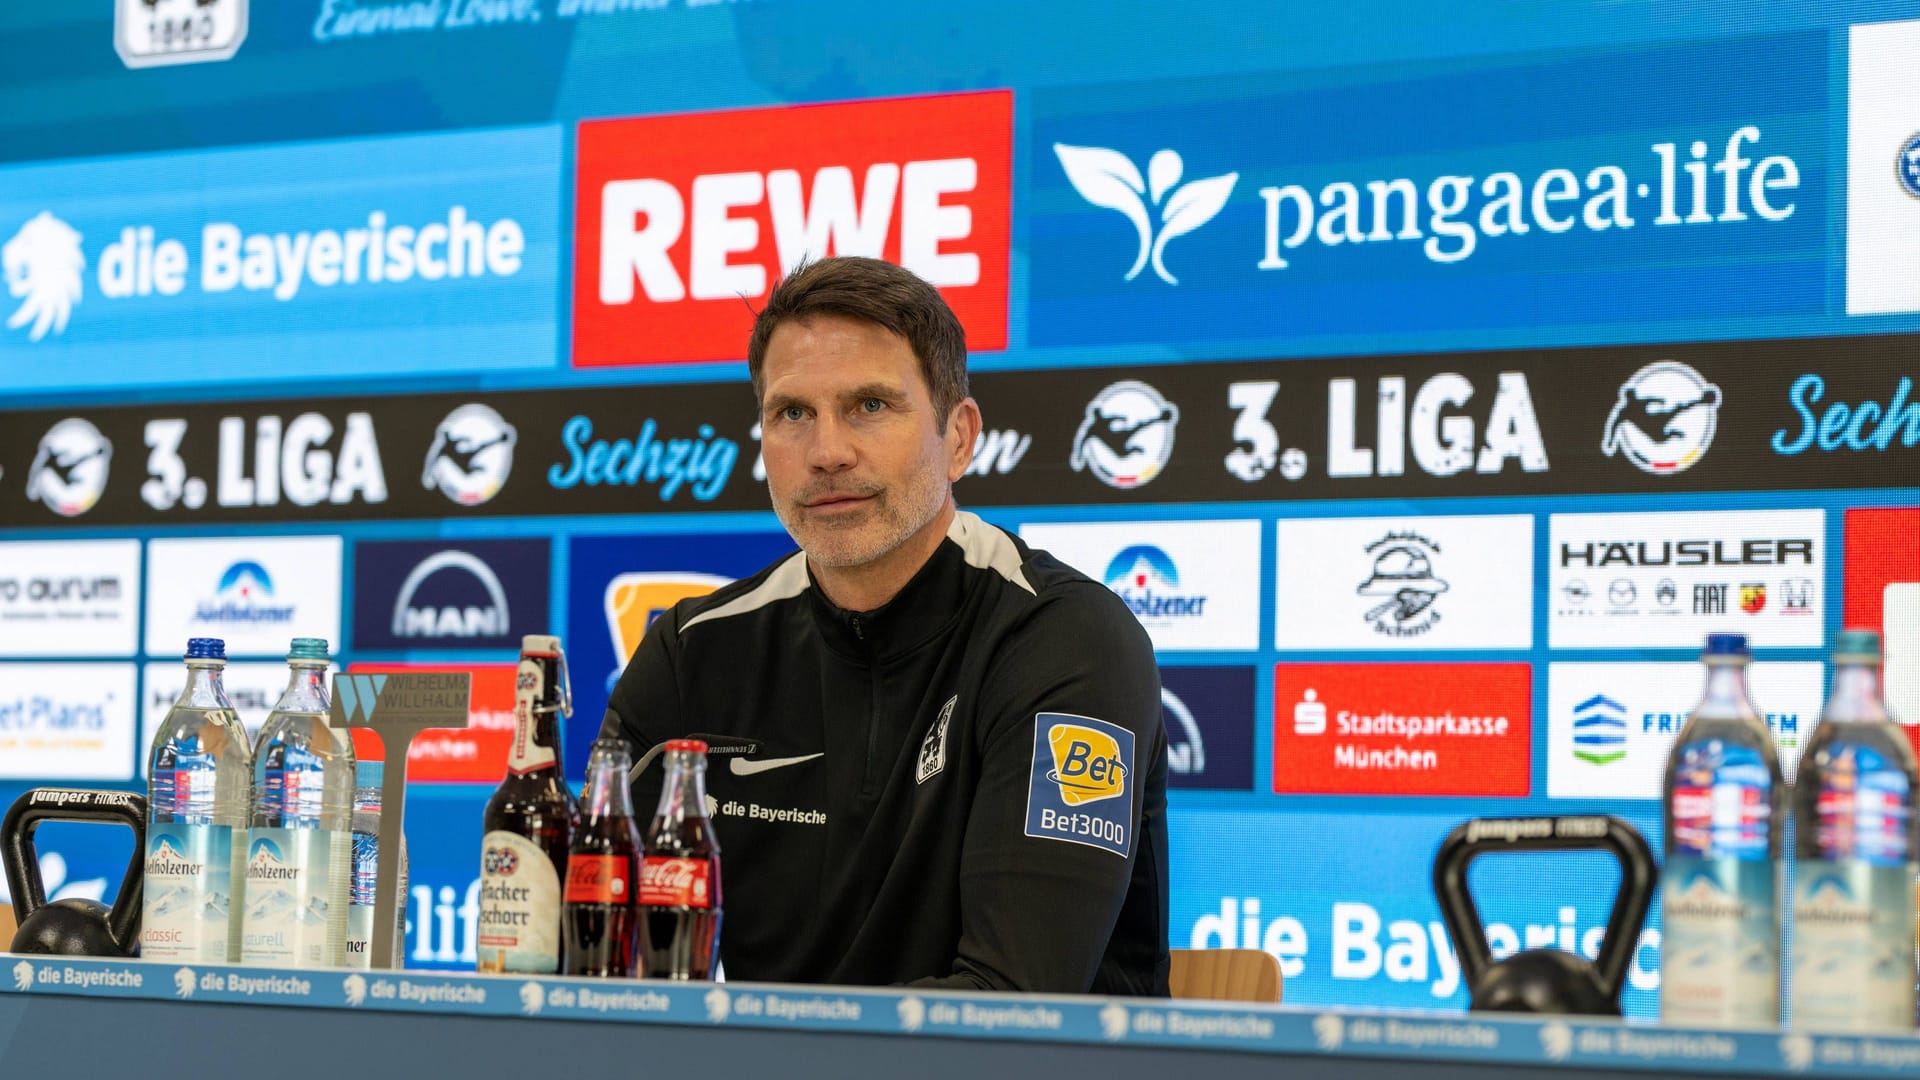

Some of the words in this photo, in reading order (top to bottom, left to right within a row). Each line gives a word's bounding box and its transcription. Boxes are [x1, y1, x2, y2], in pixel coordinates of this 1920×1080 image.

[601, 158, 980, 305] REWE
[98, 226, 188, 297] die
[202, 205, 523, 300] Bayerische
[1224, 381, 1308, 482] 3.
[1327, 372, 1549, 478] LIGA
[1771, 373, 1920, 456] Sech
[141, 418, 207, 510] 3.
[217, 412, 388, 506] LIGA
[547, 415, 739, 500] Sechzig
[1560, 539, 1814, 567] HÄUSLER
[28, 576, 120, 601] aurum
[1692, 584, 1729, 615] FIAT
[404, 606, 497, 637] MAN
[384, 693, 467, 709] WILLHALM
[1337, 711, 1508, 739] Stadtsparkasse
[922, 757, 938, 777] 1860
[1061, 741, 1123, 786] Bet
[1335, 744, 1437, 769] München
[30, 790, 91, 806] jumpers
[94, 793, 131, 806] FITNESS
[722, 801, 745, 816] die
[749, 804, 827, 825] Bayerische
[1041, 808, 1124, 845] Bet3000
[481, 880, 530, 902] acker
[1191, 898, 1308, 977] die
[1332, 902, 1663, 998] Bayerisc
[38, 966, 60, 984] die
[64, 967, 143, 988] Bayerische
[200, 972, 225, 991] die
[227, 974, 311, 996] Bayerische
[370, 980, 396, 1000] die
[399, 981, 486, 1004] Bayerische
[549, 988, 575, 1009] die
[578, 989, 670, 1013] Bayerische
[734, 995, 761, 1016] die
[765, 996, 862, 1021] Bayerische
